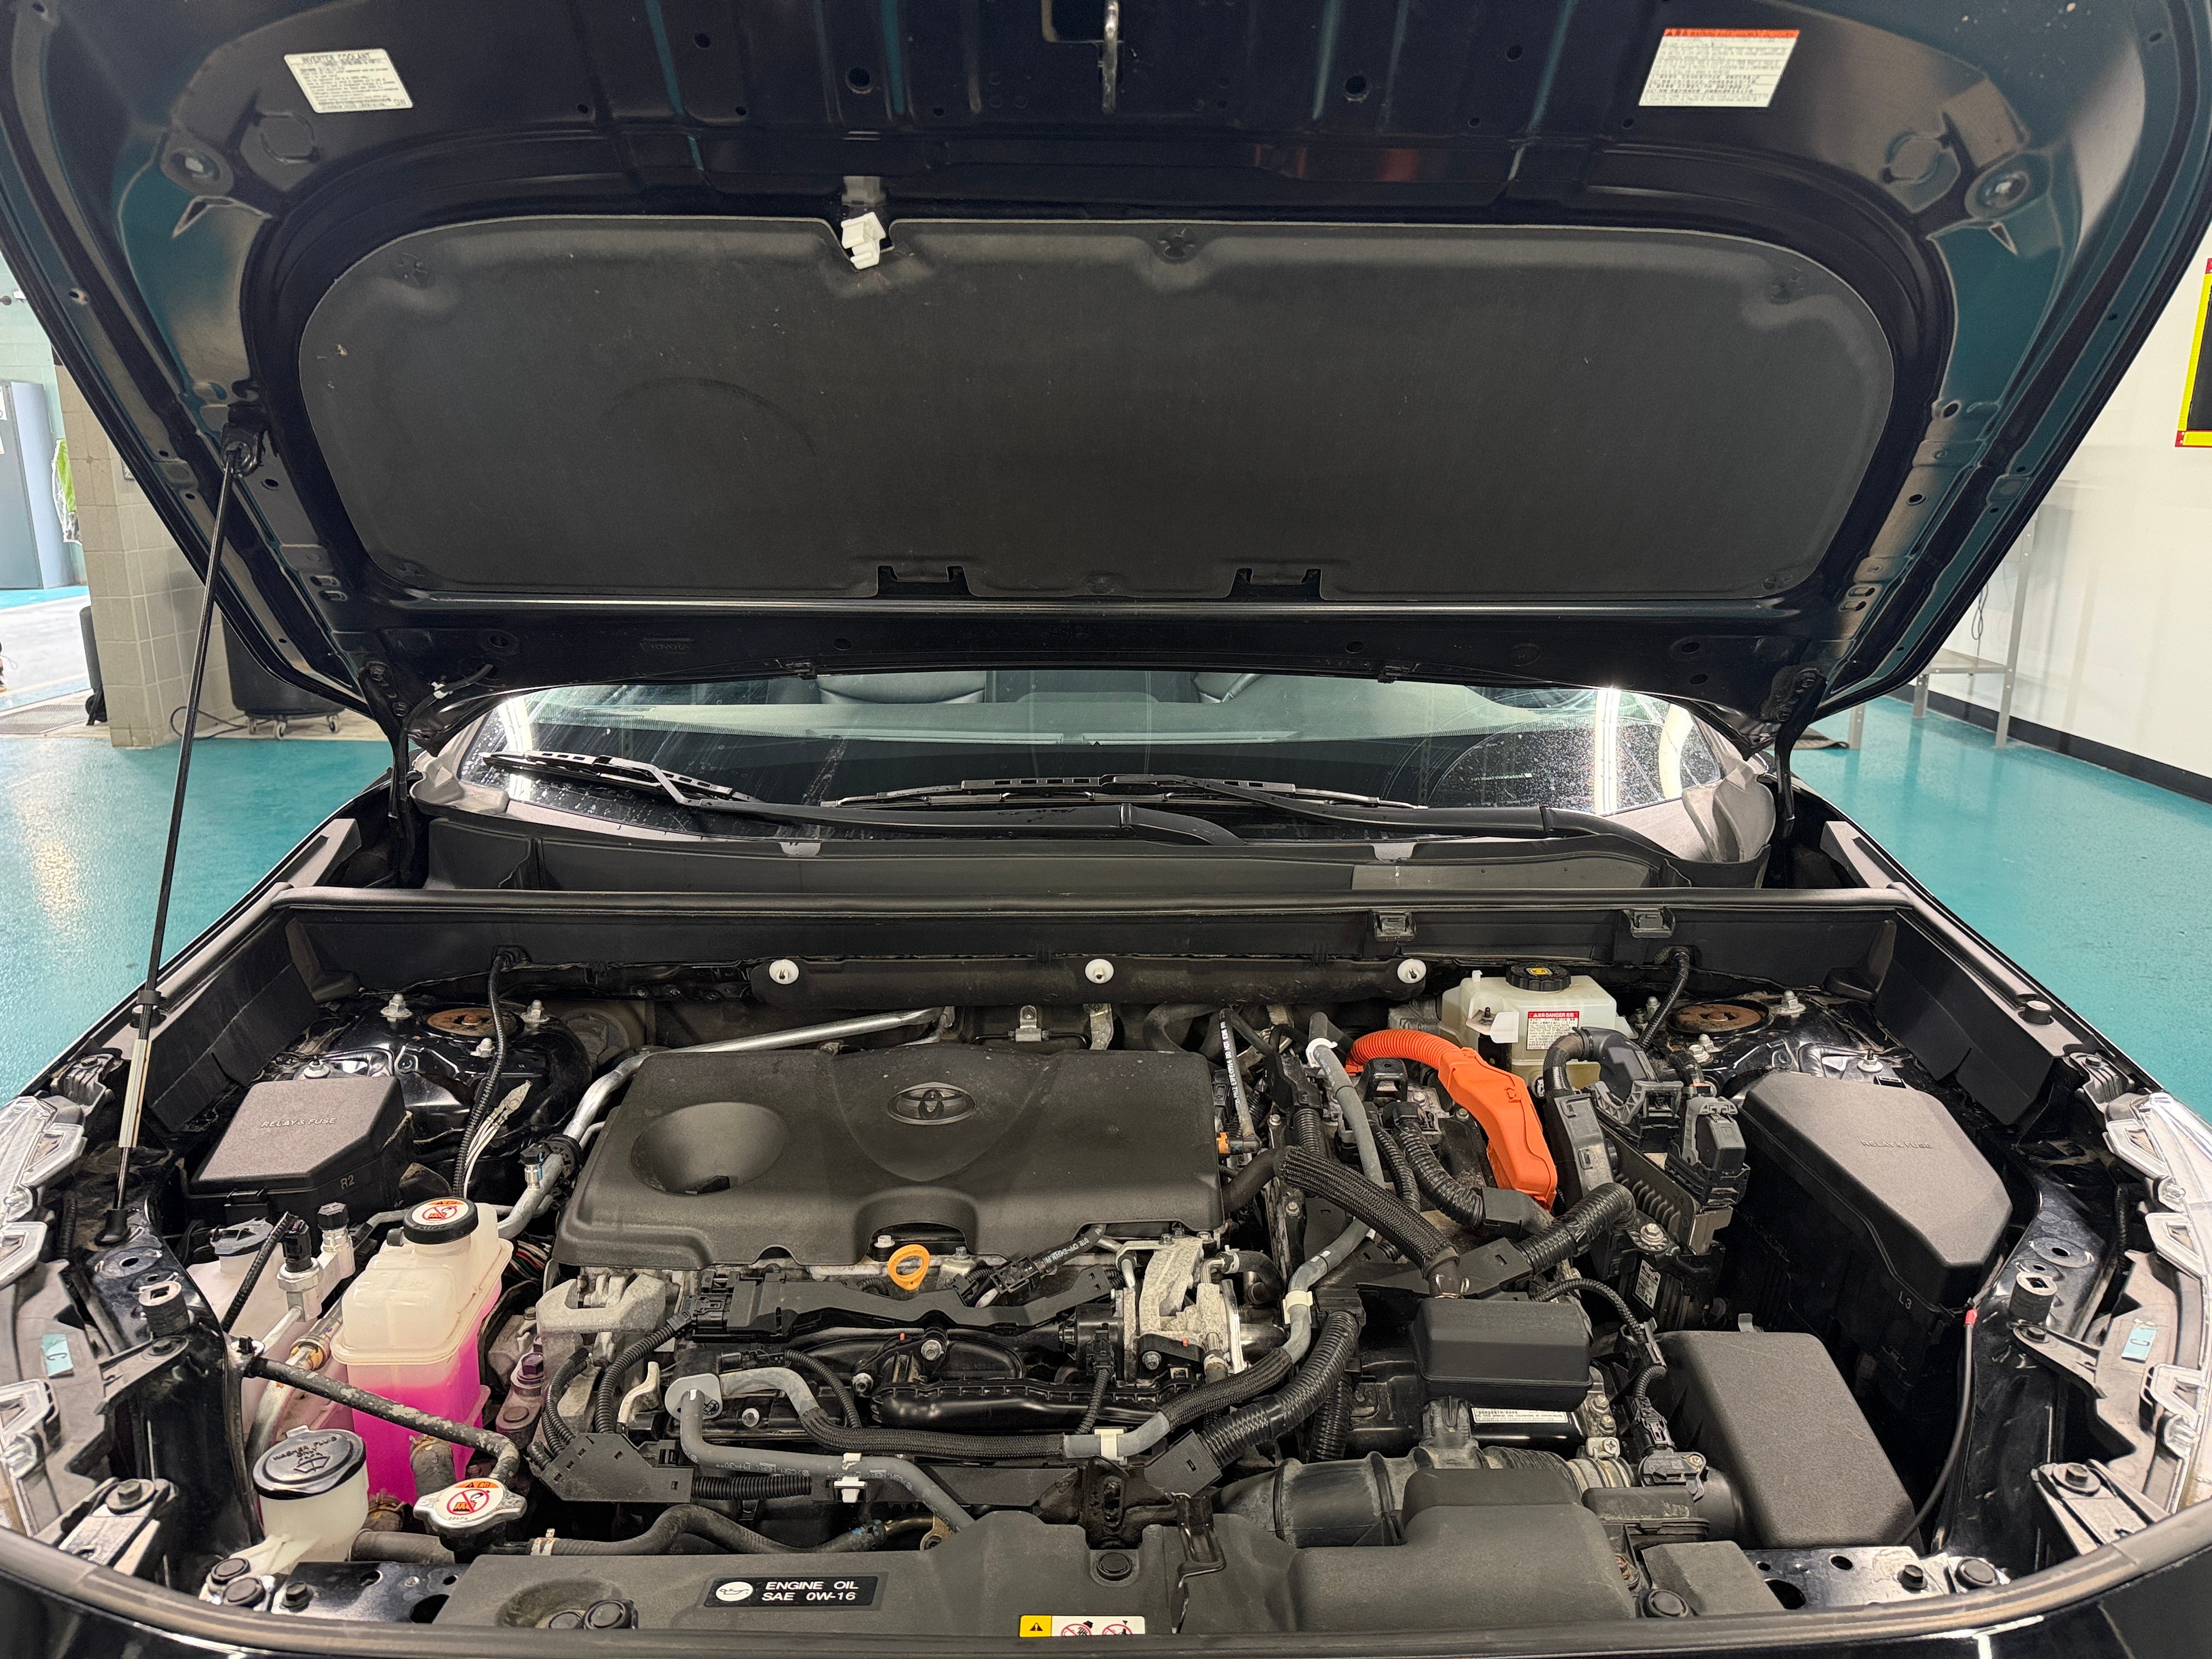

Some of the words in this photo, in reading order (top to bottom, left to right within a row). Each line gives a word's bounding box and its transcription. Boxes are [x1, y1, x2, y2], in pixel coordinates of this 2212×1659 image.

[261, 1120, 297, 1128] RELAY
[1861, 1140, 1893, 1149] RELAY
[1905, 1142, 1933, 1150] FUSE
[340, 1174, 355, 1190] R2
[1899, 1291, 1912, 1310] L3
[765, 1581, 824, 1590] ENGINE
[833, 1581, 859, 1589] OIL
[761, 1592, 795, 1601] SAE
[806, 1592, 857, 1601] 0W-16
